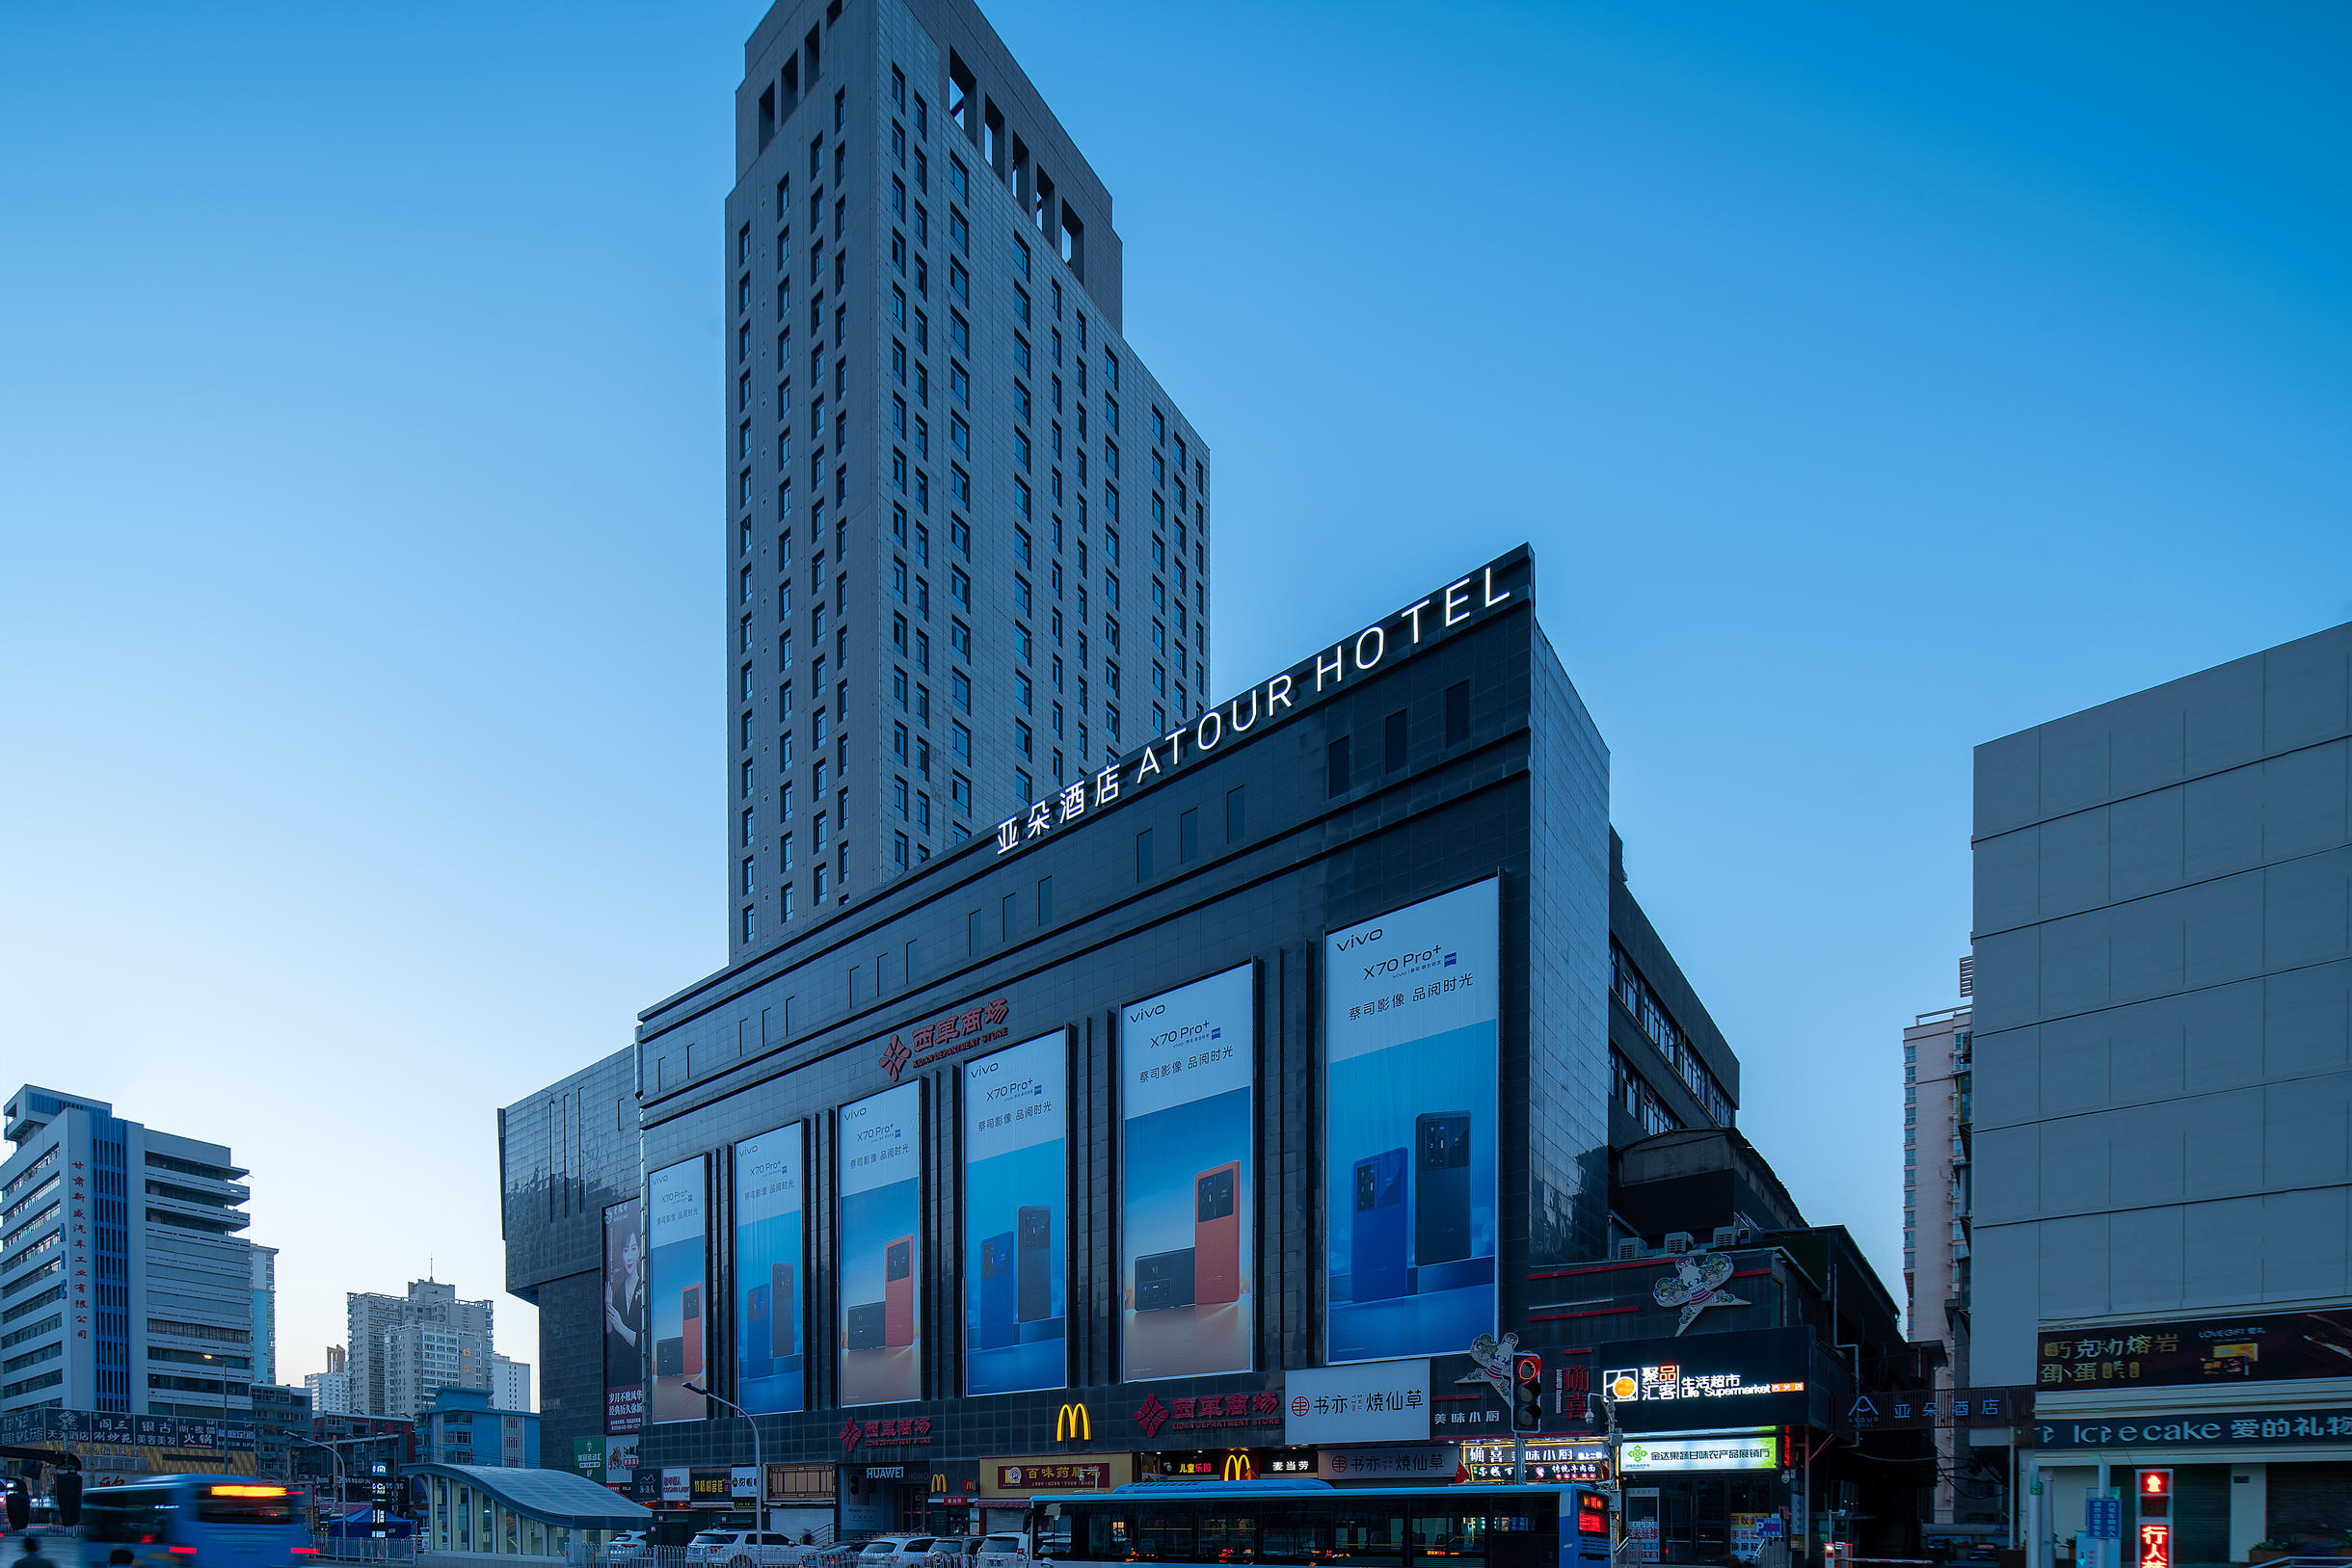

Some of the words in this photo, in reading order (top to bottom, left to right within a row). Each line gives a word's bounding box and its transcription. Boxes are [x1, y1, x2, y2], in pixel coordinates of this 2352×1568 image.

[1136, 674, 1293, 784] ATOUR
[1317, 565, 1510, 693] HOTEL
[997, 762, 1120, 855] 亚朵酒店
[1336, 928, 1383, 952] vivo
[1363, 958, 1399, 980] X70
[1403, 944, 1442, 968] Pro+
[1350, 993, 1404, 1022] 蔡司影像
[1412, 972, 1474, 1002] 品阅时光
[1130, 1004, 1165, 1023] vivo
[934, 1037, 980, 1060] DEPARTMENT
[981, 1026, 1008, 1043] STORE
[1150, 1031, 1177, 1049] X70
[1180, 1020, 1210, 1039] Pro+
[971, 1062, 999, 1078] vivo
[1139, 1060, 1182, 1083] 蔡司影像
[1188, 1046, 1233, 1070] 品阅时光
[986, 1086, 1007, 1102] X70
[1010, 1077, 1032, 1094] Pro+
[844, 1107, 867, 1121] vivo
[857, 1129, 874, 1142] X70
[875, 1122, 894, 1136] Pro+
[738, 1145, 758, 1156] vivo
[652, 1174, 669, 1185] vivo
[750, 1164, 764, 1177] X70
[1642, 1365, 1676, 1383] 聚品
[1681, 1374, 1741, 1389] 生活超市
[1642, 1383, 1676, 1401] 汇客
[1704, 1384, 1772, 1397] Supermarket
[1313, 1395, 1349, 1415] 书亦
[1892, 1397, 2002, 1420] 亚朵酒店
[1172, 1422, 1194, 1430] XIDAN
[1196, 1419, 1249, 1429] DEPARTMENT
[1252, 1417, 1280, 1426] STORE
[1434, 1410, 1500, 1424] 美味小厨
[2143, 1421, 2222, 1442] cake
[2231, 1417, 2352, 1440] 爱的礼物
[183, 1433, 213, 1445] 火锅
[1650, 1448, 1771, 1461] 金达果蔬甘味农产品展销厅
[866, 1467, 904, 1479] HUAWEI
[1179, 1463, 1212, 1474] 儿童乐园
[1271, 1460, 1310, 1472] 麦当劳
[1350, 1456, 1380, 1472] 书亦
